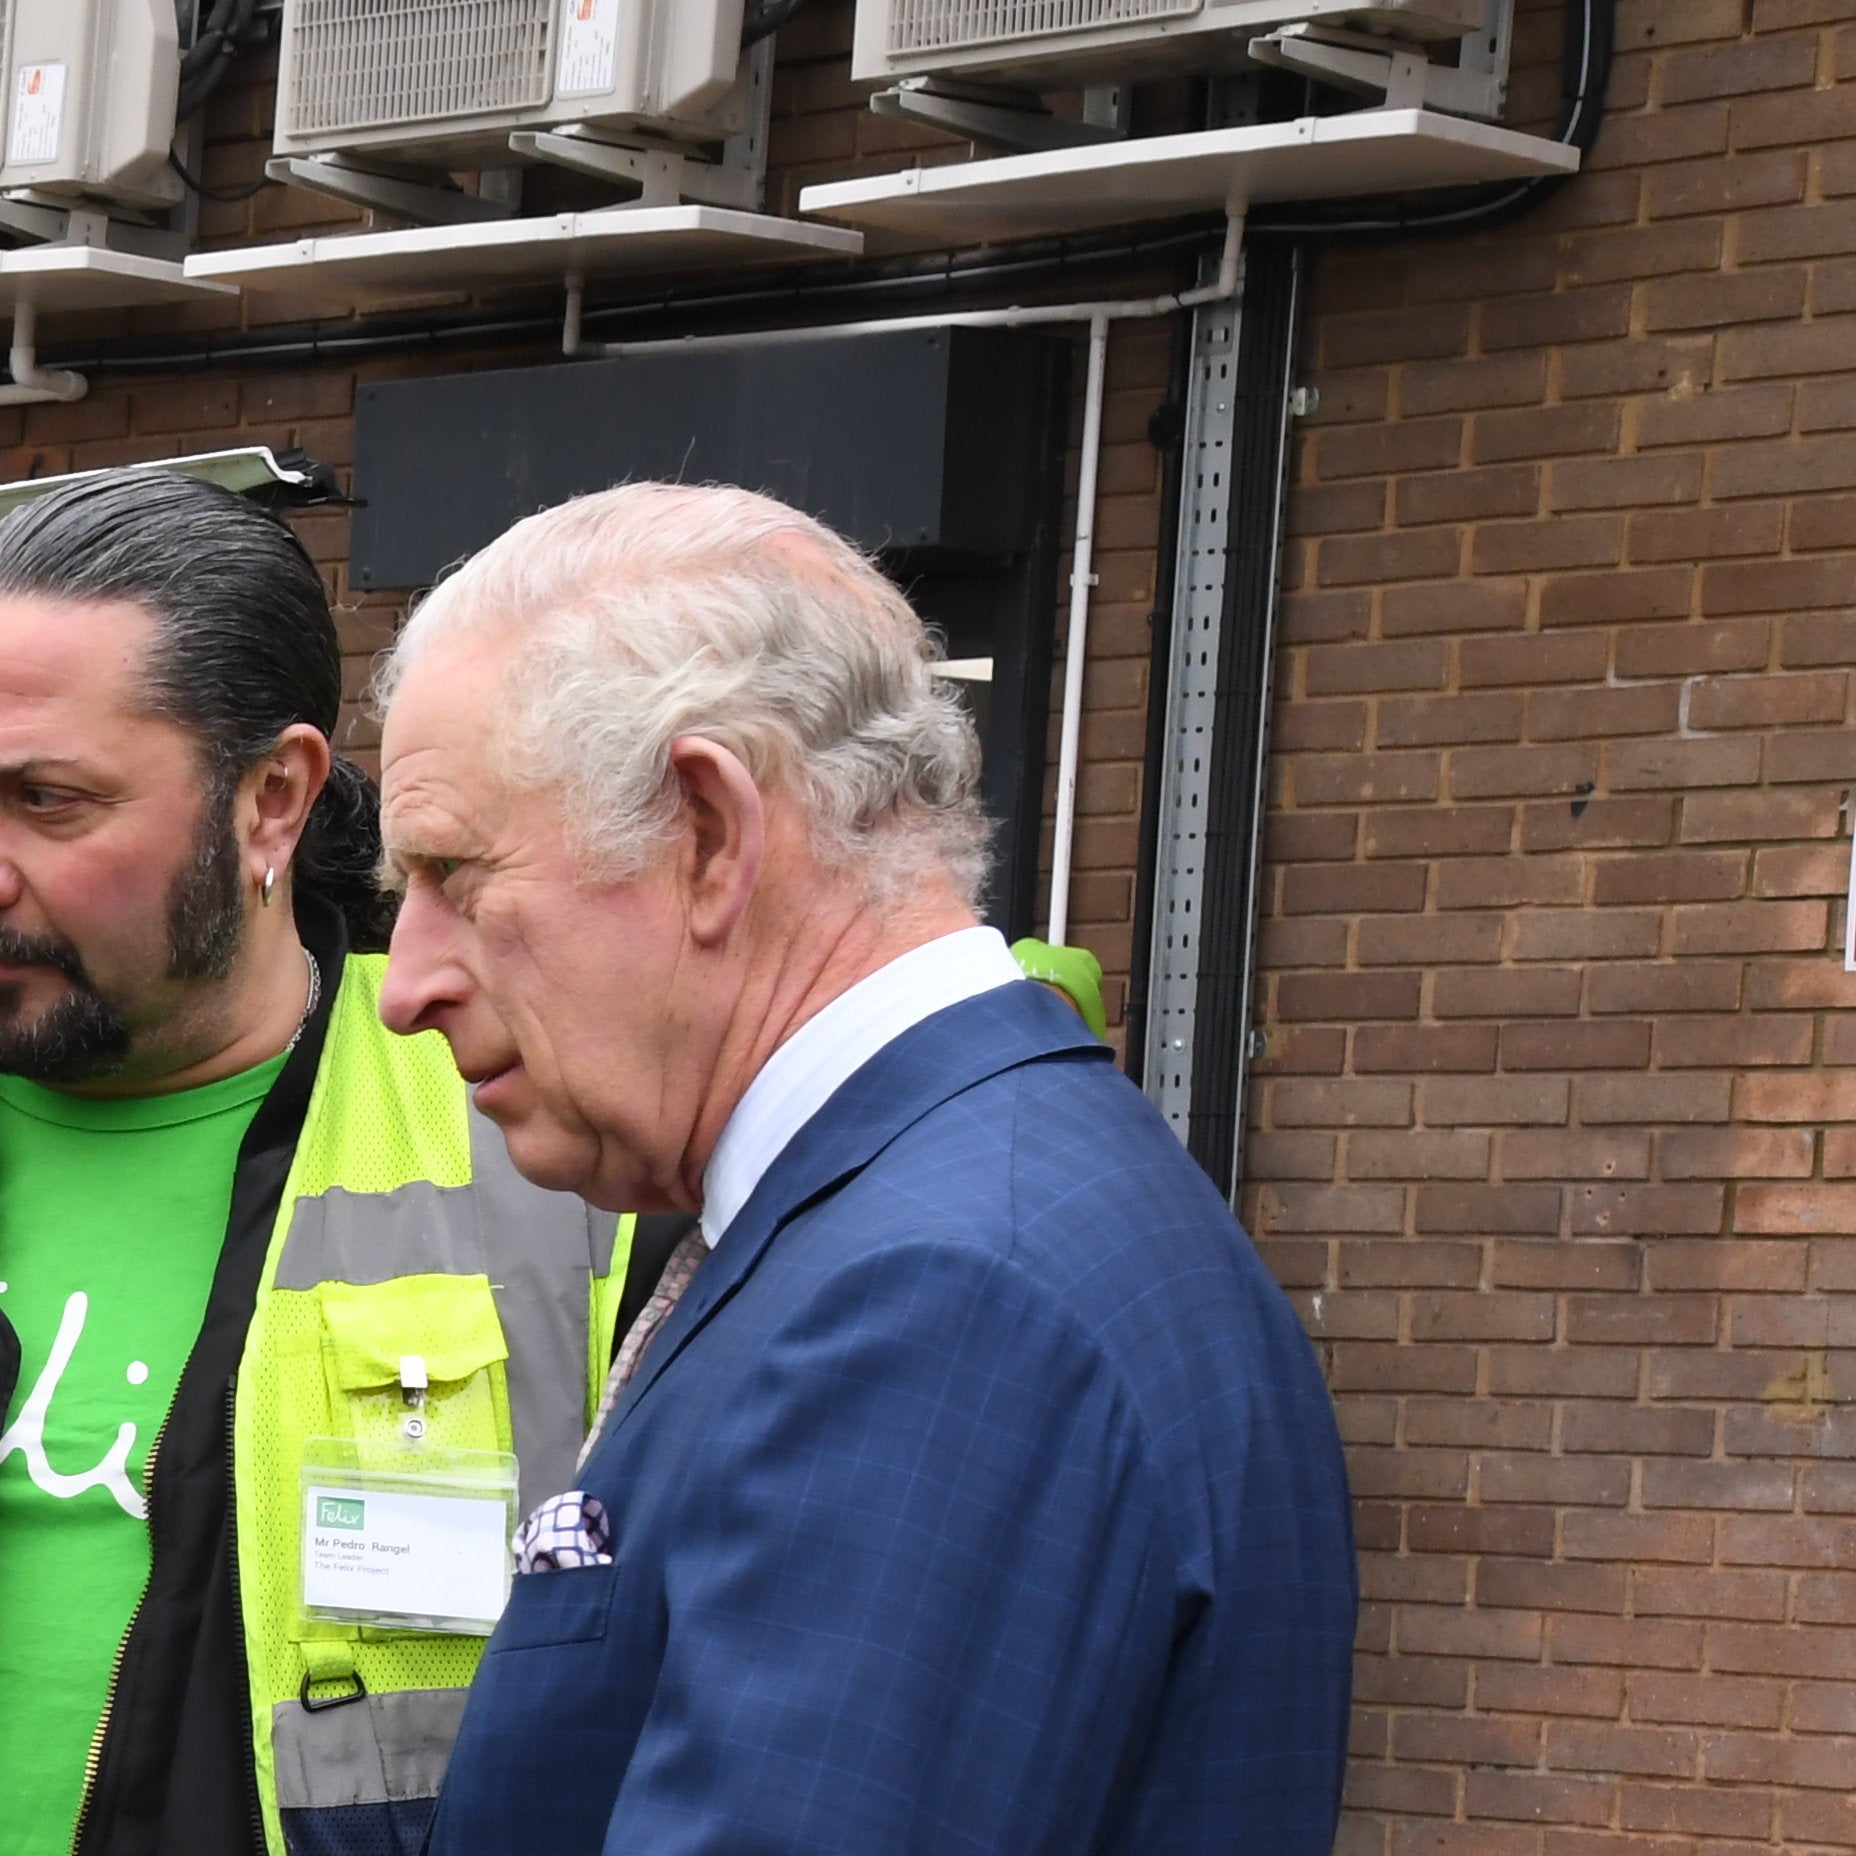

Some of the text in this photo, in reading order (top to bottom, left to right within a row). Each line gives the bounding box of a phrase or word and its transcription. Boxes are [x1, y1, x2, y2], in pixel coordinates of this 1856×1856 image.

[320, 1501, 360, 1525] Felix
[314, 1536, 410, 1556] Mr Pedro Rangel
[314, 1550, 335, 1558] Team
[314, 1560, 330, 1569] The
[357, 1564, 389, 1576] Project
